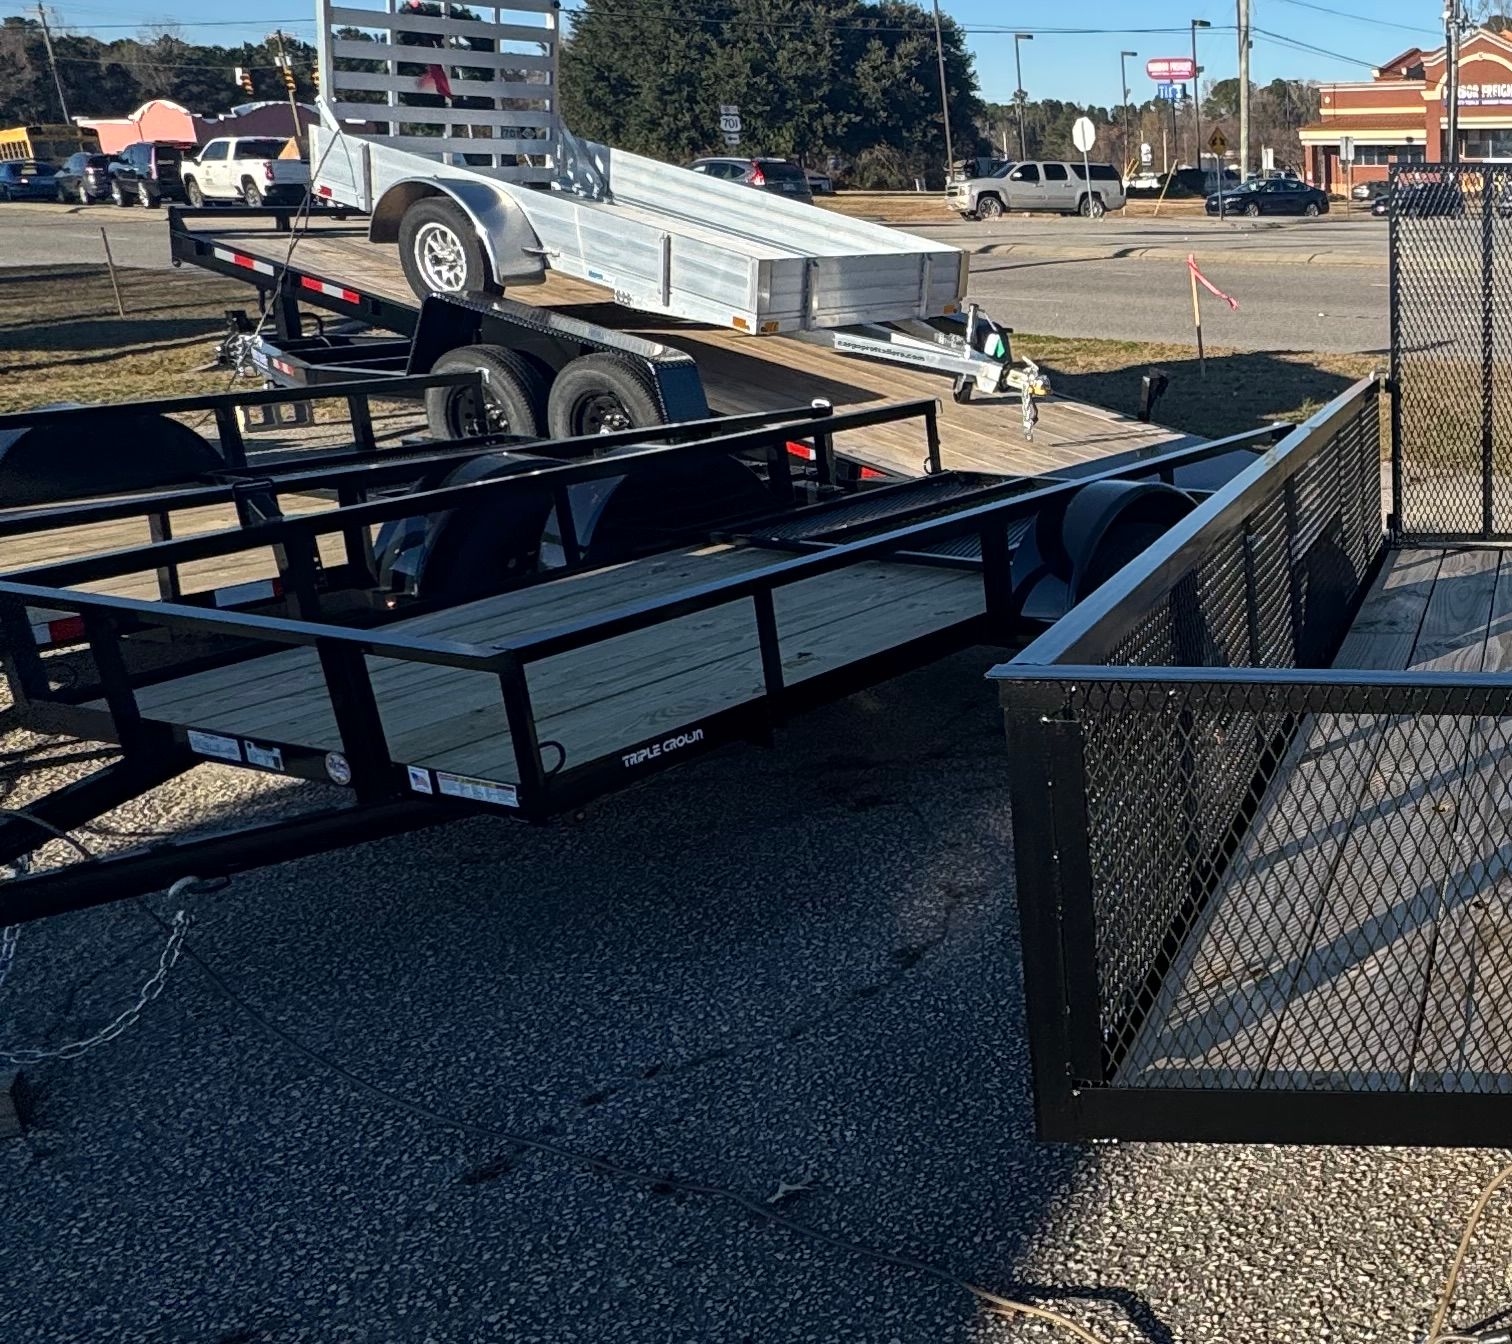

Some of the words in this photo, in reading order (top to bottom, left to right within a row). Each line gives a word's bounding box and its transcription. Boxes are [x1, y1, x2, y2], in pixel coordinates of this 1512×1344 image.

[722, 118, 739, 129] 701
[622, 744, 661, 768] TRIPLE
[662, 728, 704, 752] CROWN
